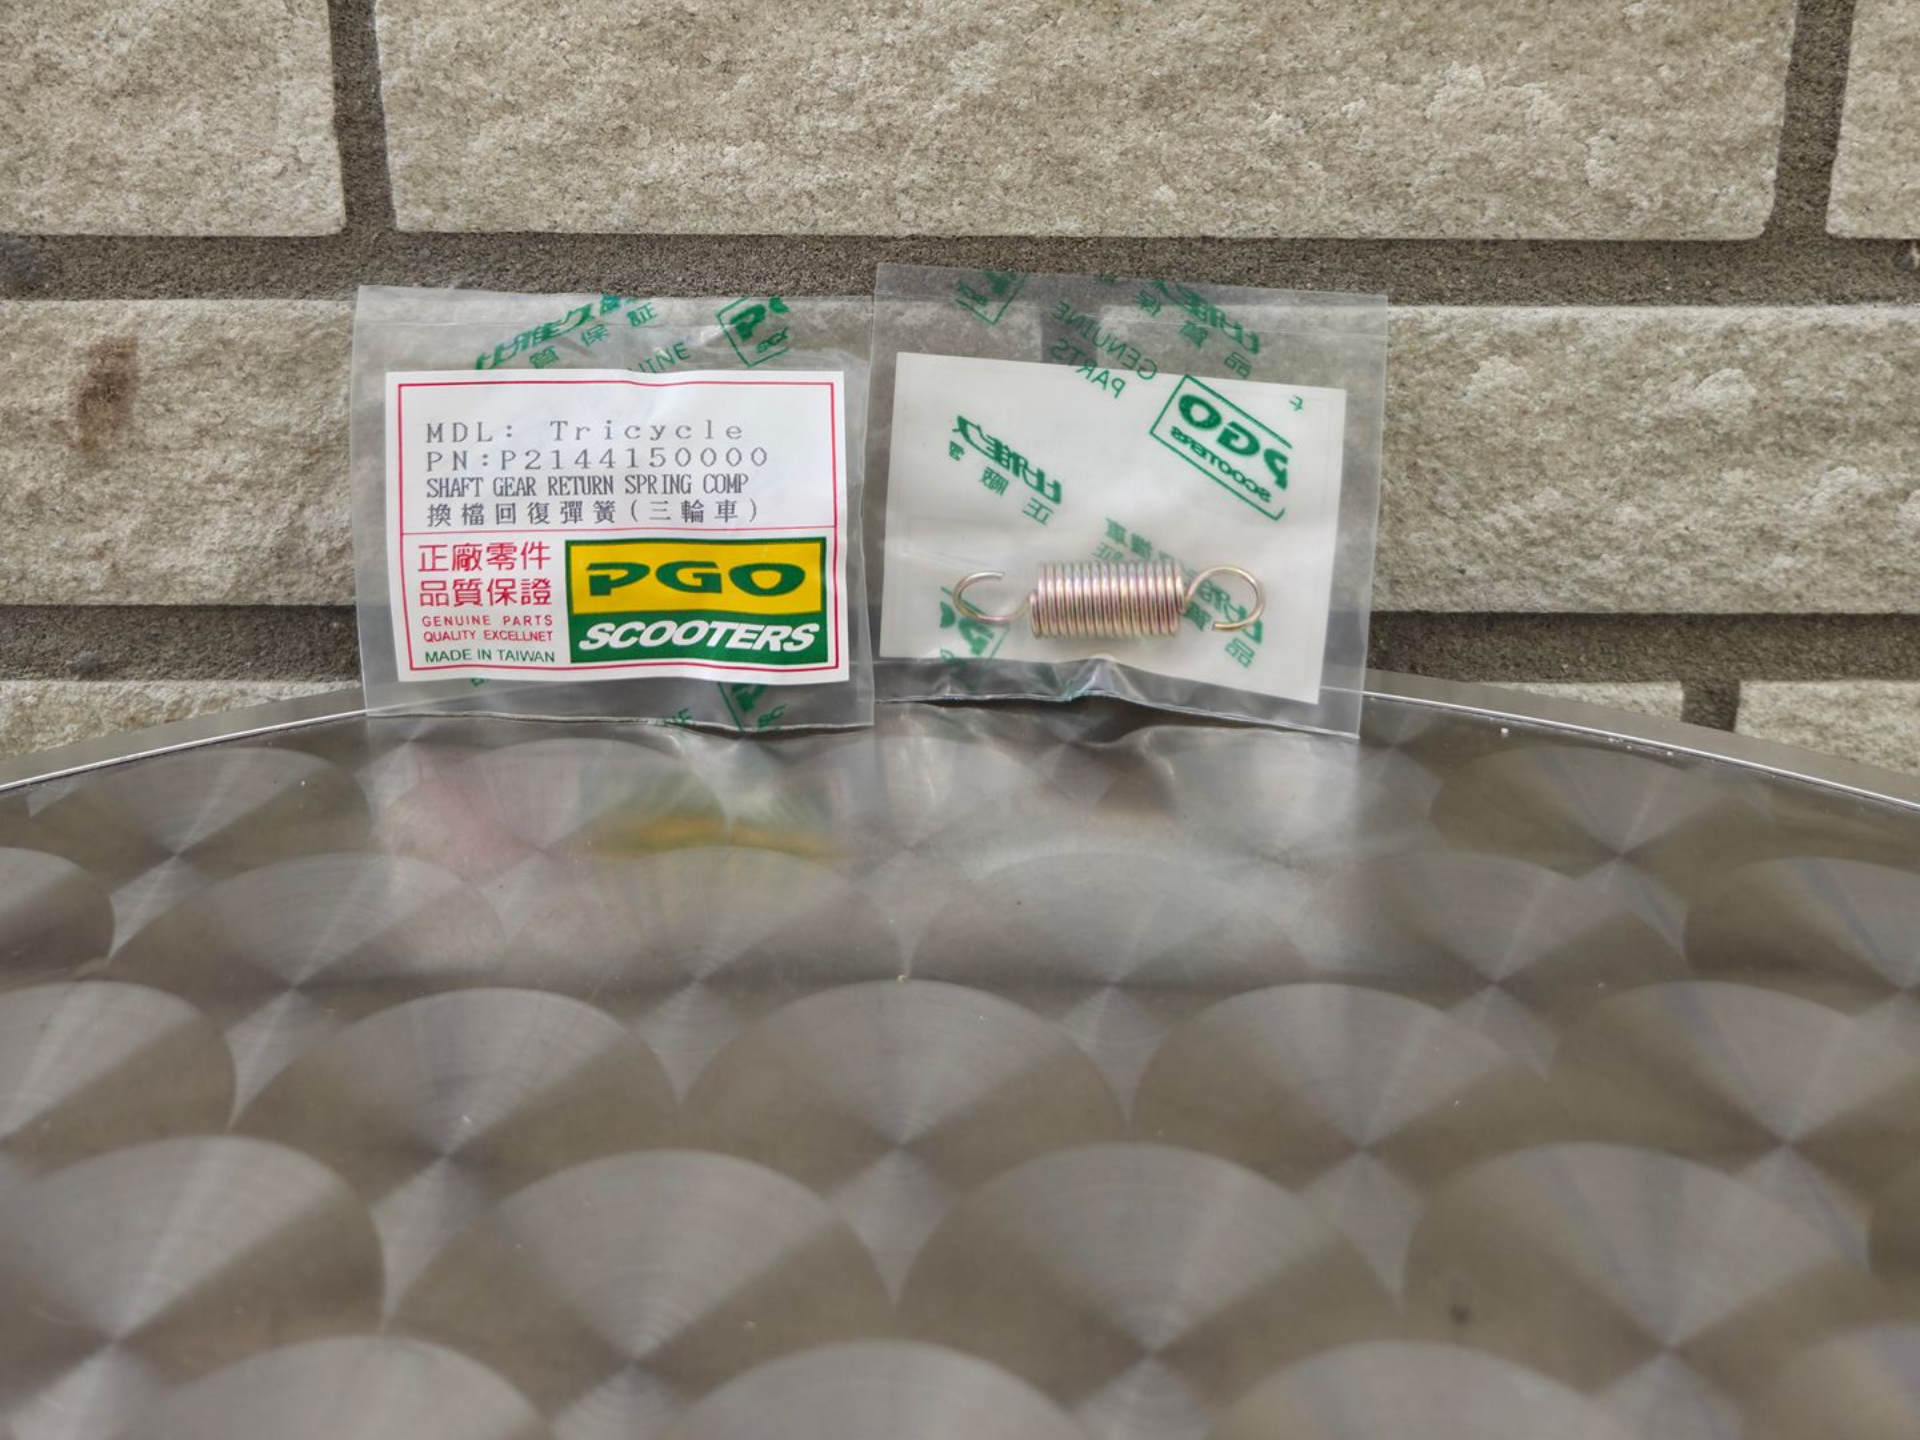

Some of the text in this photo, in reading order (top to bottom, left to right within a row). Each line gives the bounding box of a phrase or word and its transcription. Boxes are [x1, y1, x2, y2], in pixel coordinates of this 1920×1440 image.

[426, 419, 743, 443] MDL: Tricycle
[426, 446, 769, 472] PN:P2144150000
[426, 473, 749, 498] SHAFT GEAR RETURN SPRING COMP
[418, 541, 552, 572] 正廠零件
[586, 560, 806, 597] PGO
[420, 578, 552, 607] 品質保證
[422, 615, 553, 627] GENUINE PARTS
[424, 630, 553, 642] QUALITY EXCELLNET
[578, 620, 820, 652] SCOOTERS
[425, 649, 555, 663] MADE IN TAIWAN
